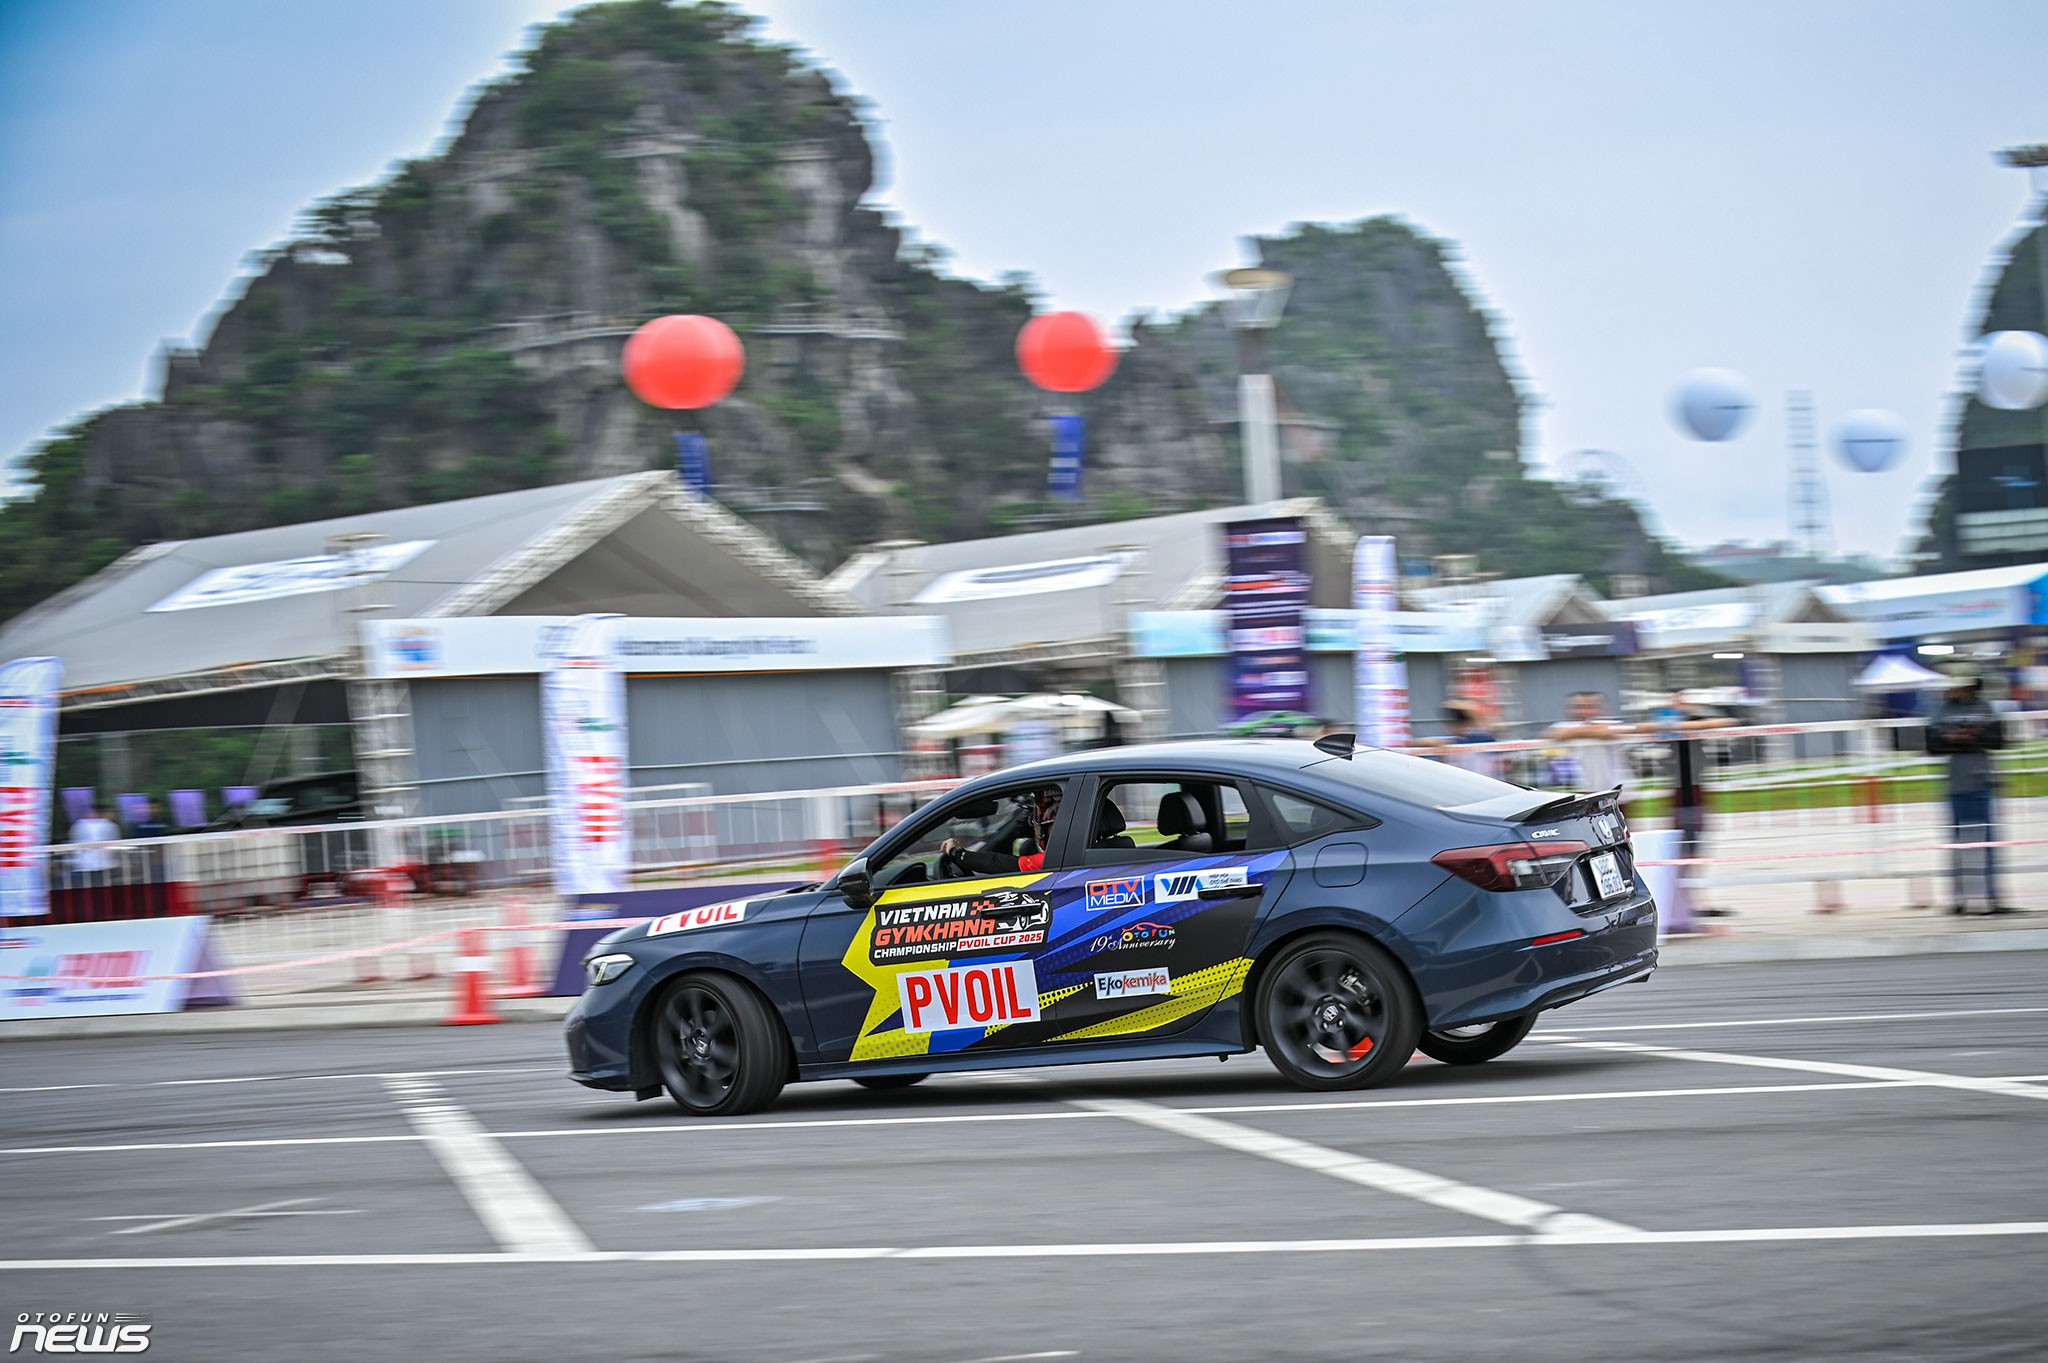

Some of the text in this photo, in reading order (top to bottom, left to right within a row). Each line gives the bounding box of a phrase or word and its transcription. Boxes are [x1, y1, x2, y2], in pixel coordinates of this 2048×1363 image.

[1089, 879, 1141, 896] OTV
[1090, 892, 1142, 907] MEDIA
[880, 902, 968, 926] VIETNAM
[875, 918, 996, 946] GYMKHANA
[873, 933, 1042, 959] CHAMPIONSHIP PVOIL CUP 2025
[1097, 972, 1167, 996] Ekokemika
[905, 966, 1032, 1028] PVOIL
